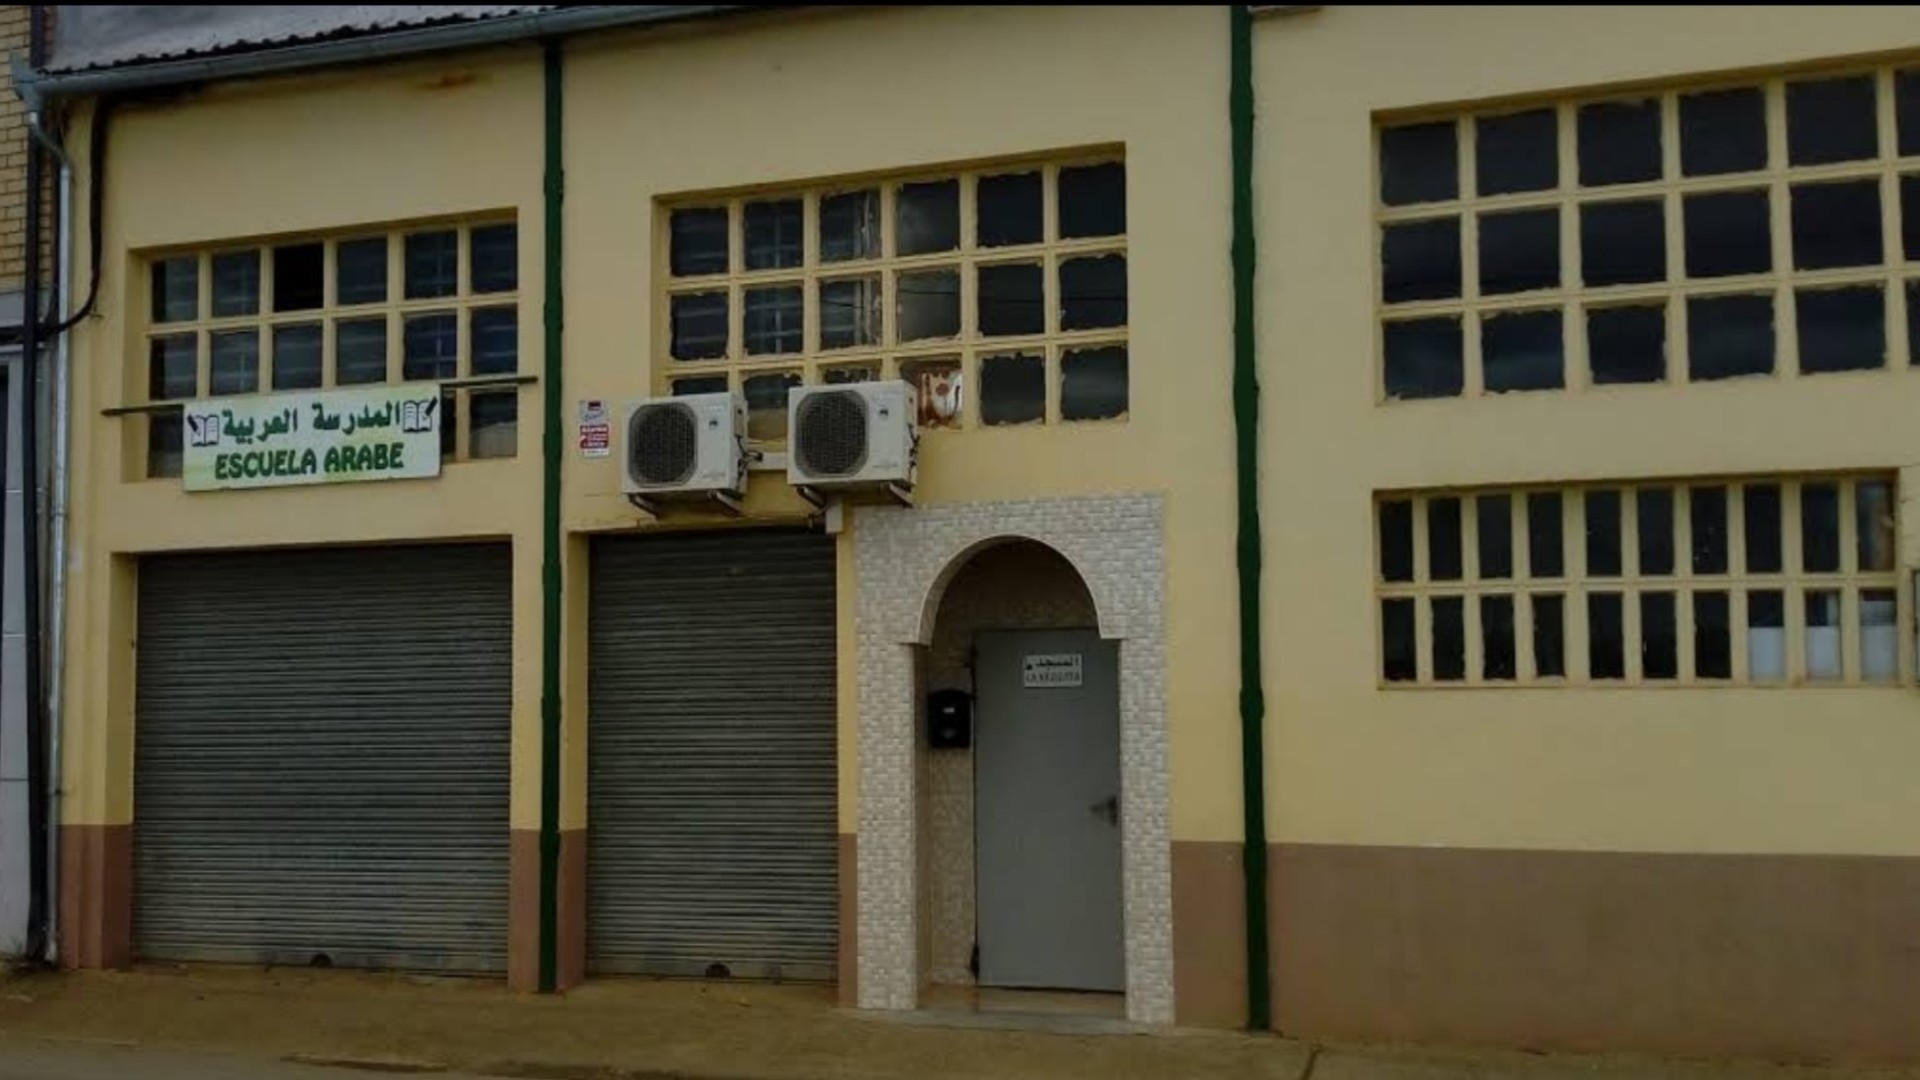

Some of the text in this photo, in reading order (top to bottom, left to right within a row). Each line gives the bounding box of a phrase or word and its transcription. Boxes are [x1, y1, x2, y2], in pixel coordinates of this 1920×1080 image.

[222, 400, 400, 446] المدرسة العربية
[215, 442, 405, 480] ESCUELA ARABE
